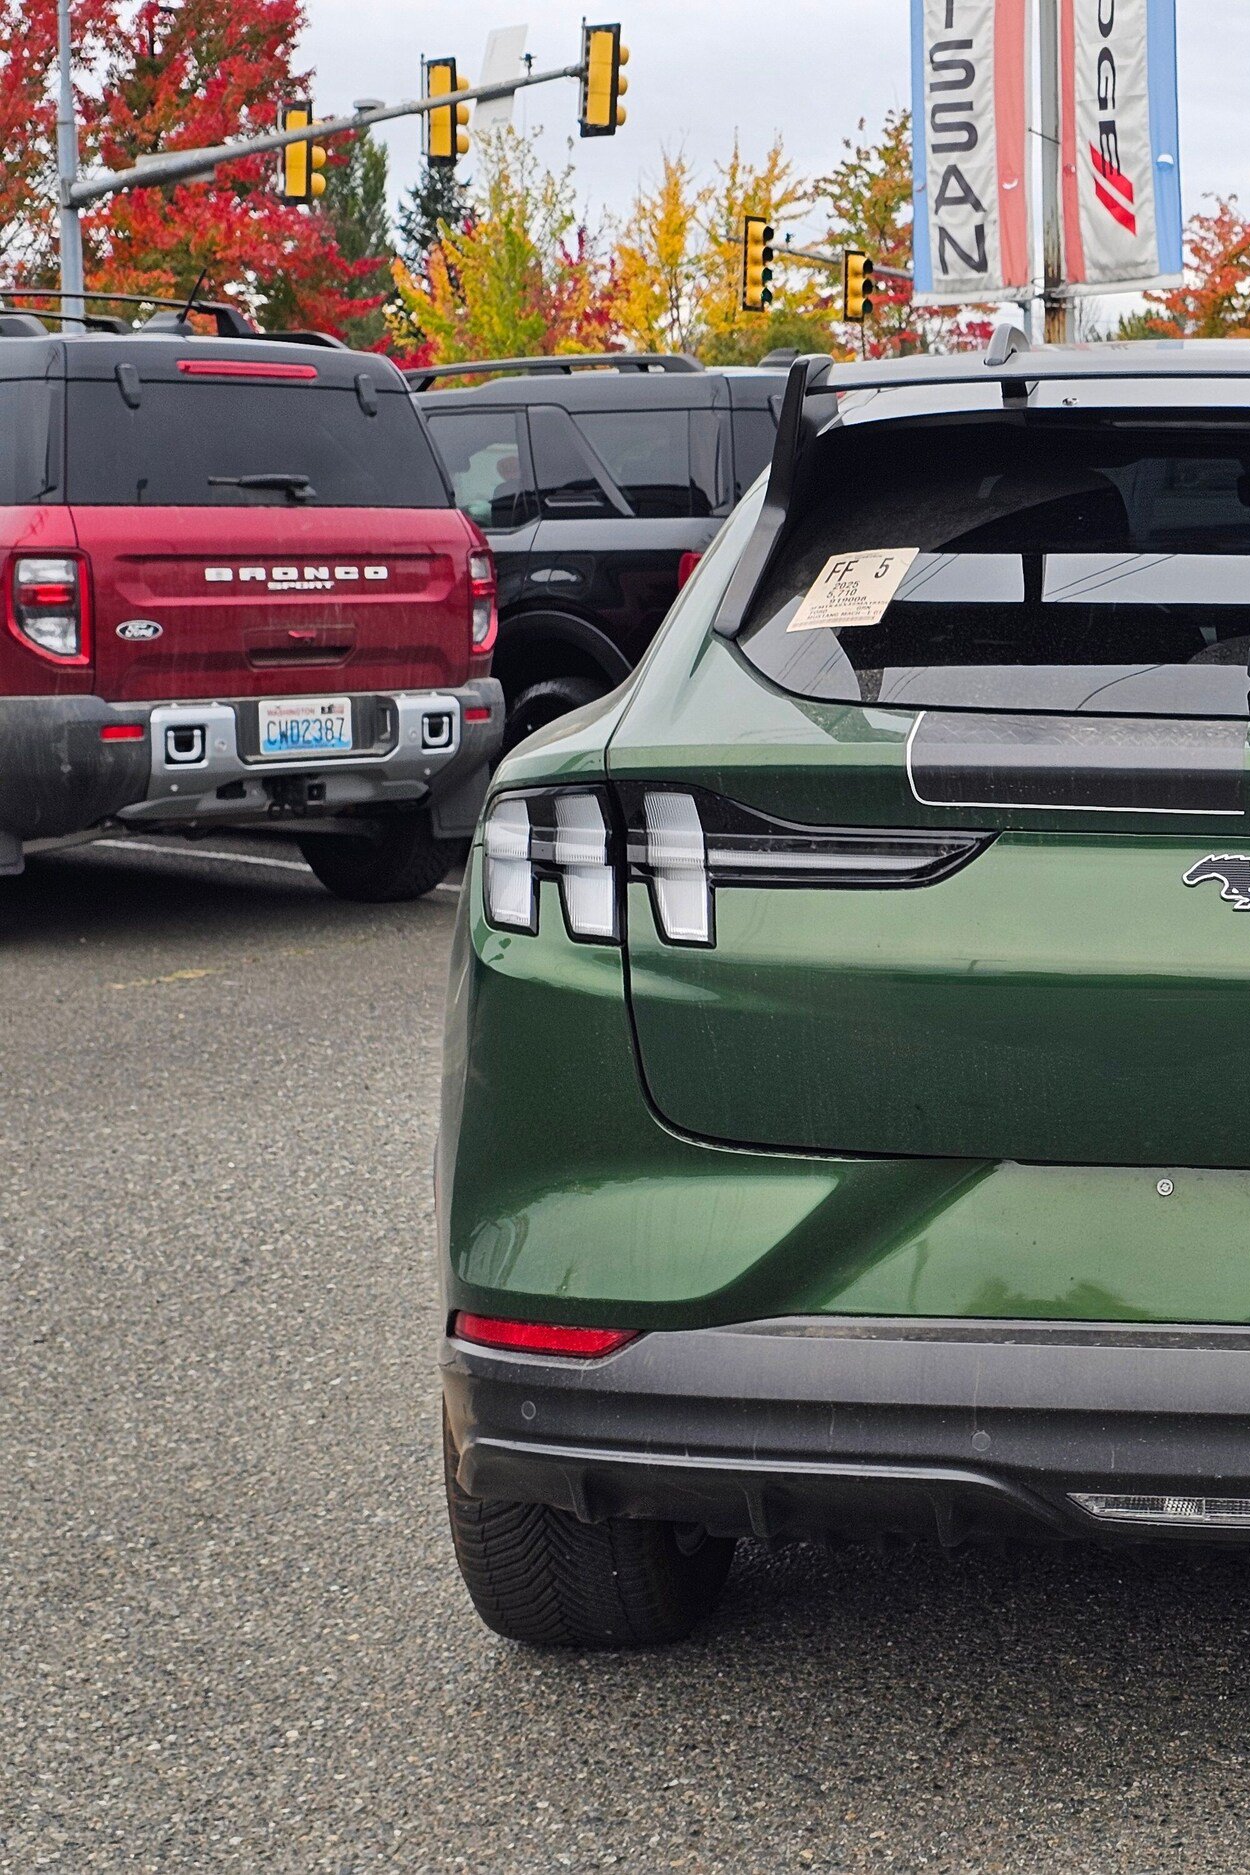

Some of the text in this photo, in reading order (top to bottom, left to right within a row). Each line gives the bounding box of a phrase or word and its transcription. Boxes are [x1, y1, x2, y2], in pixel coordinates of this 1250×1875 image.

[204, 566, 388, 581] BRONCO
[825, 557, 894, 584] FF 5
[267, 580, 335, 591] SPORT
[833, 581, 860, 591] 2025
[826, 589, 857, 599] 5,710
